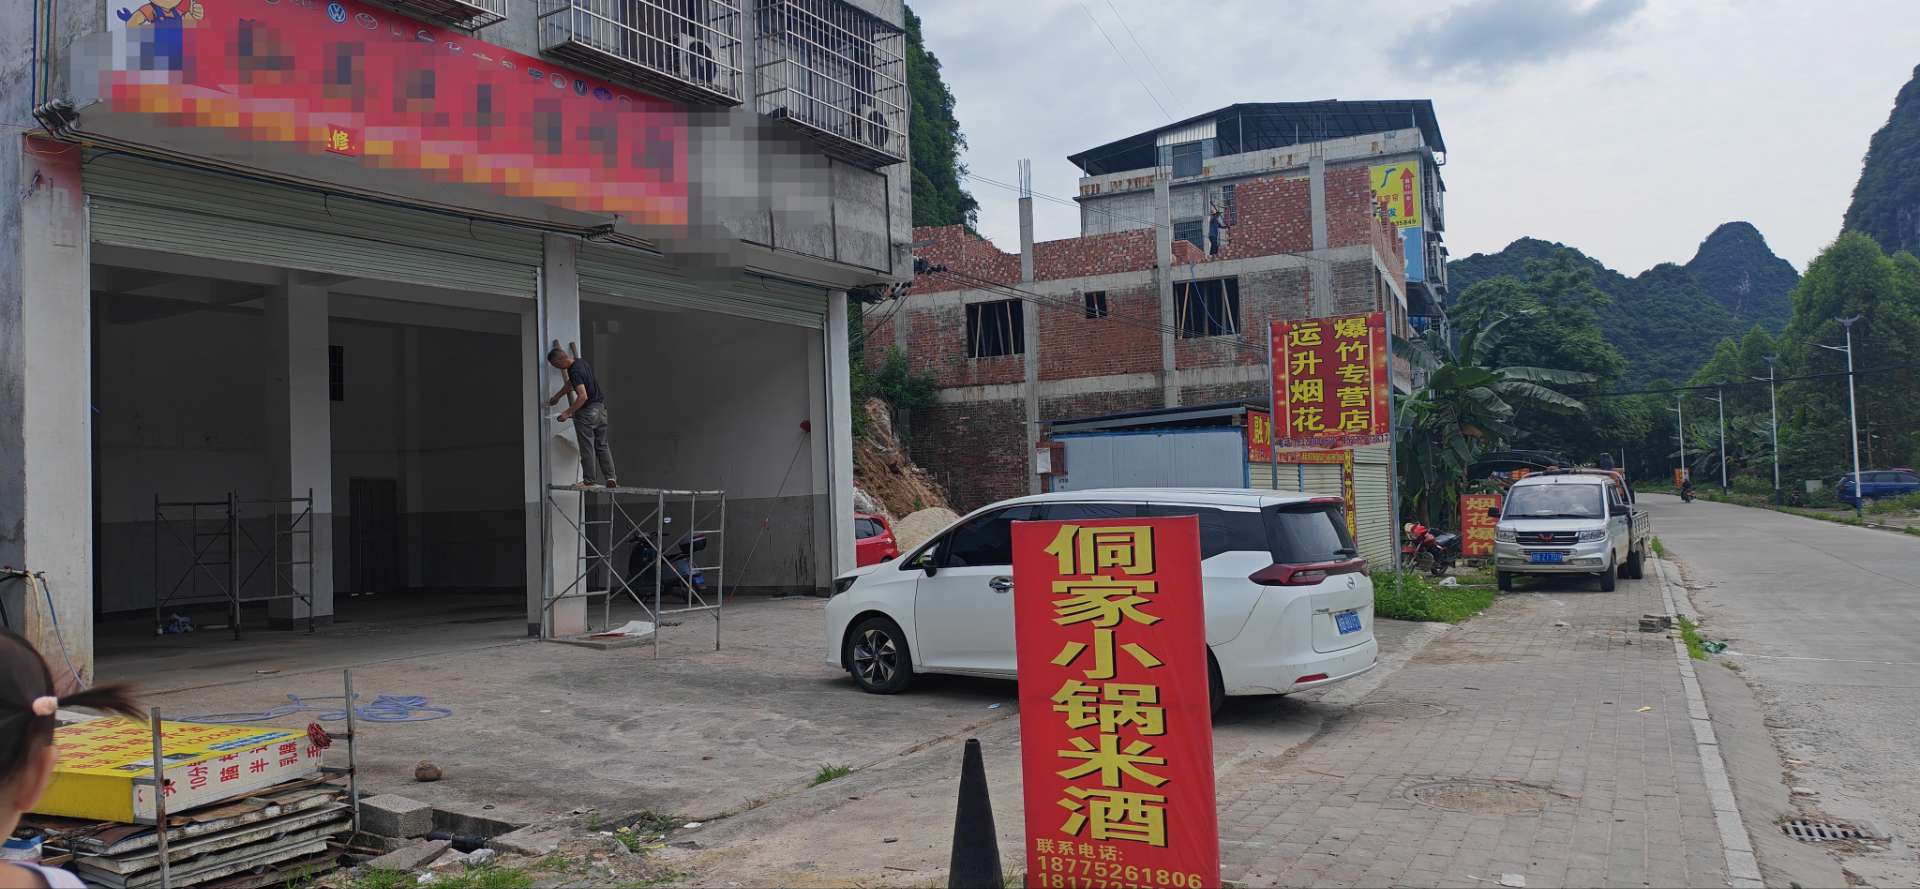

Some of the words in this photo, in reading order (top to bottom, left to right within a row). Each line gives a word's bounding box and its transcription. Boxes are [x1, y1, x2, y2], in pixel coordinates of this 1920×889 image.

[333, 129, 349, 151] 修
[1289, 322, 1324, 432] 运升烟花
[1334, 317, 1370, 433] 爆竹专营店
[1466, 496, 1497, 556] 烟花爆竹
[1044, 524, 1169, 848] 侗家小锅米酒
[1036, 838, 1124, 861] 联系电话:
[1038, 856, 1202, 889] 18775261806
